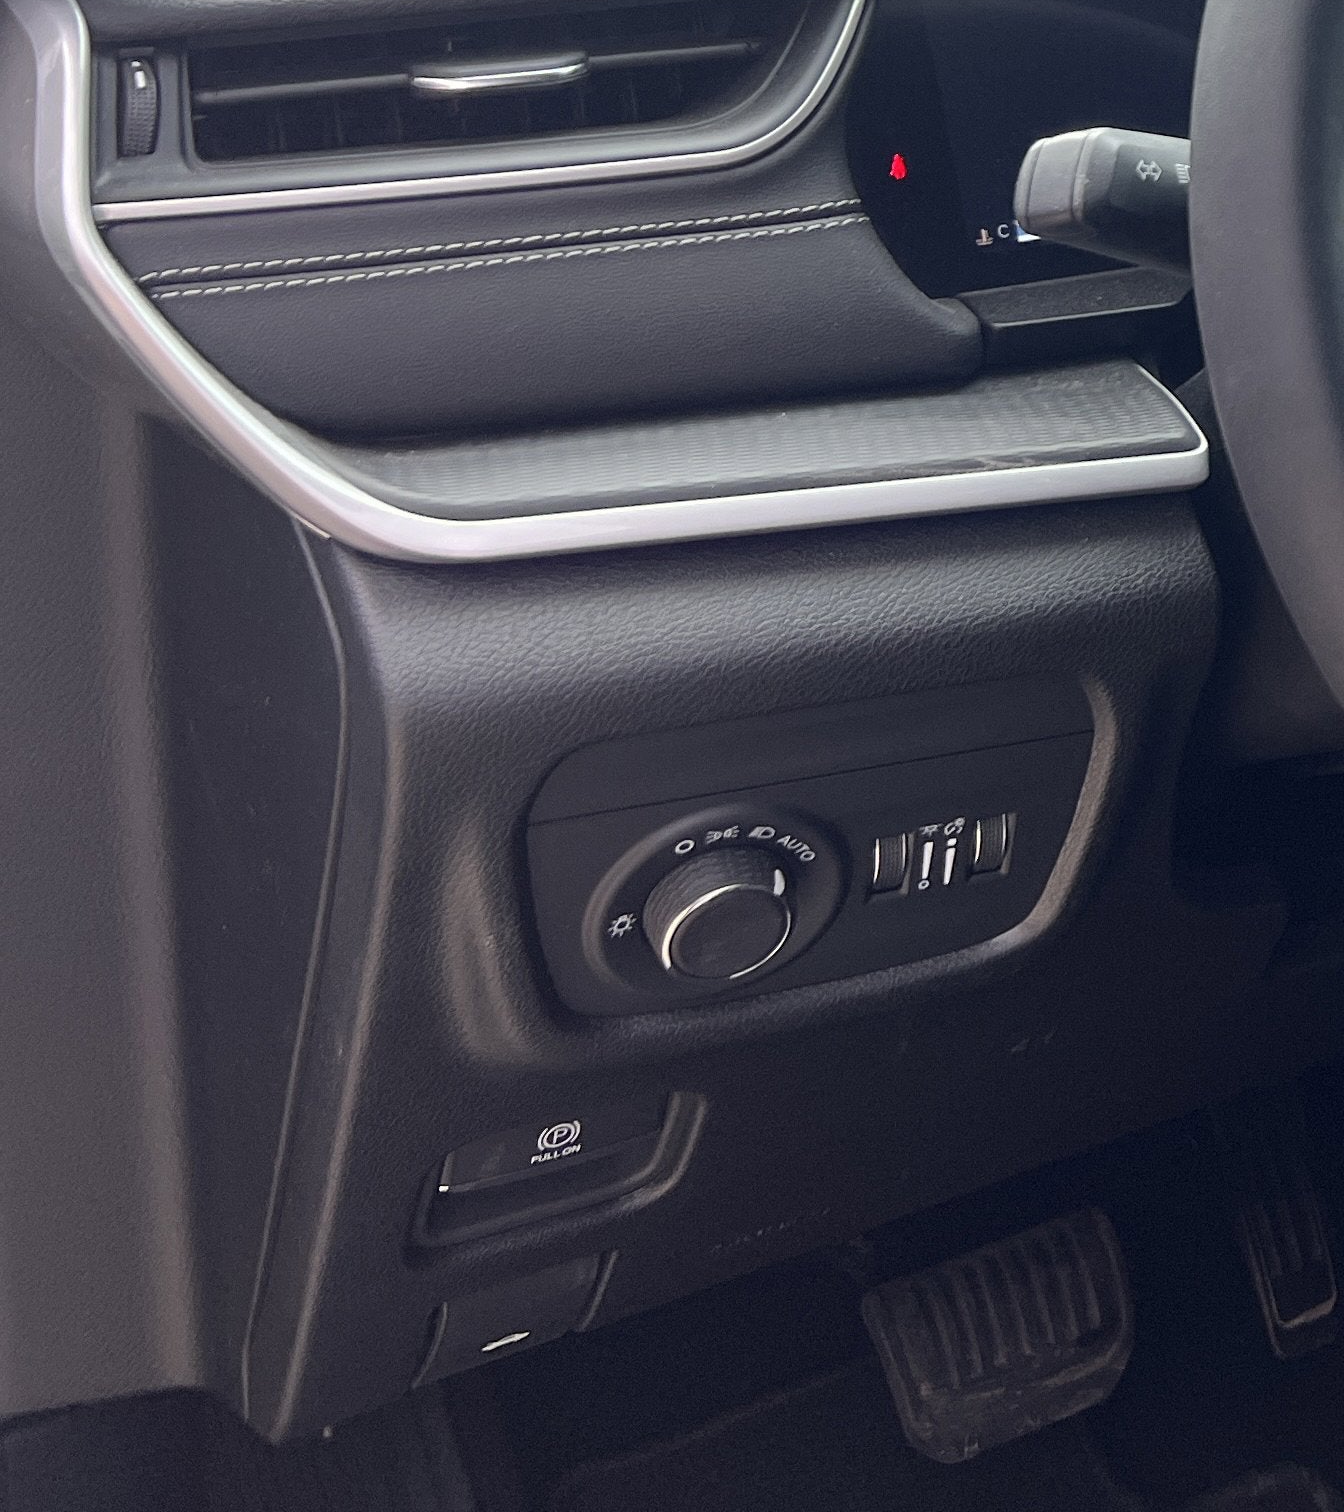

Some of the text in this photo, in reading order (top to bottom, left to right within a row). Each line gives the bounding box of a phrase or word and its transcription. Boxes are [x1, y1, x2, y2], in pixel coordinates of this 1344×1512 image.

[997, 223, 1010, 239] C
[776, 834, 816, 862] AUTO
[561, 1143, 582, 1157] ON
